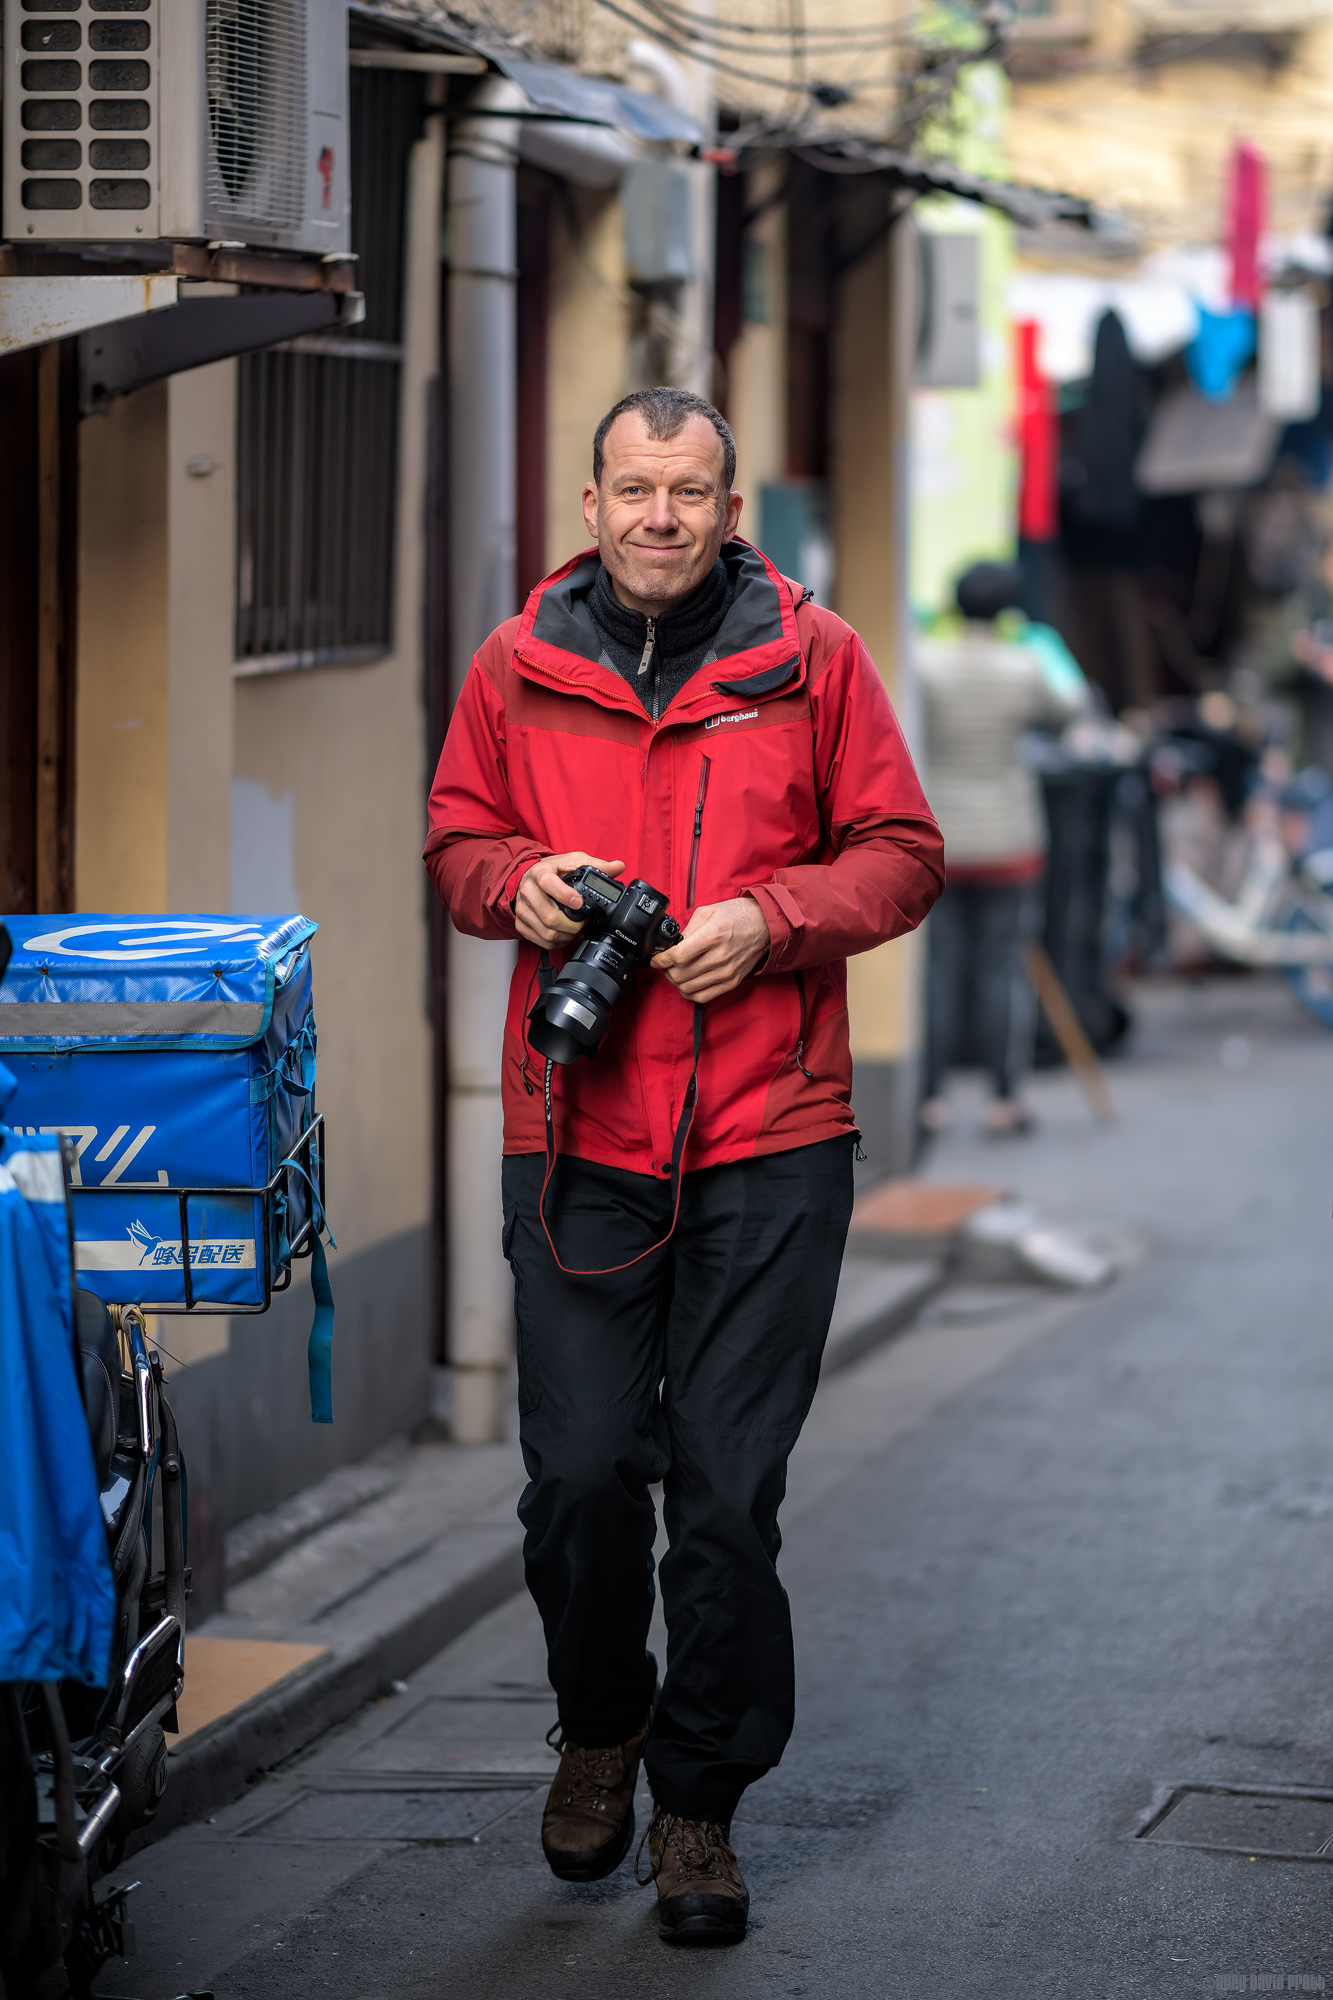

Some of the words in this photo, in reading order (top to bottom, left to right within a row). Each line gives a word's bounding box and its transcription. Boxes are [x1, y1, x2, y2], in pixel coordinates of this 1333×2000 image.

[720, 711, 758, 722] berghaus
[615, 929, 638, 946] Canon
[152, 1244, 245, 1265] 蜂鸟配送
